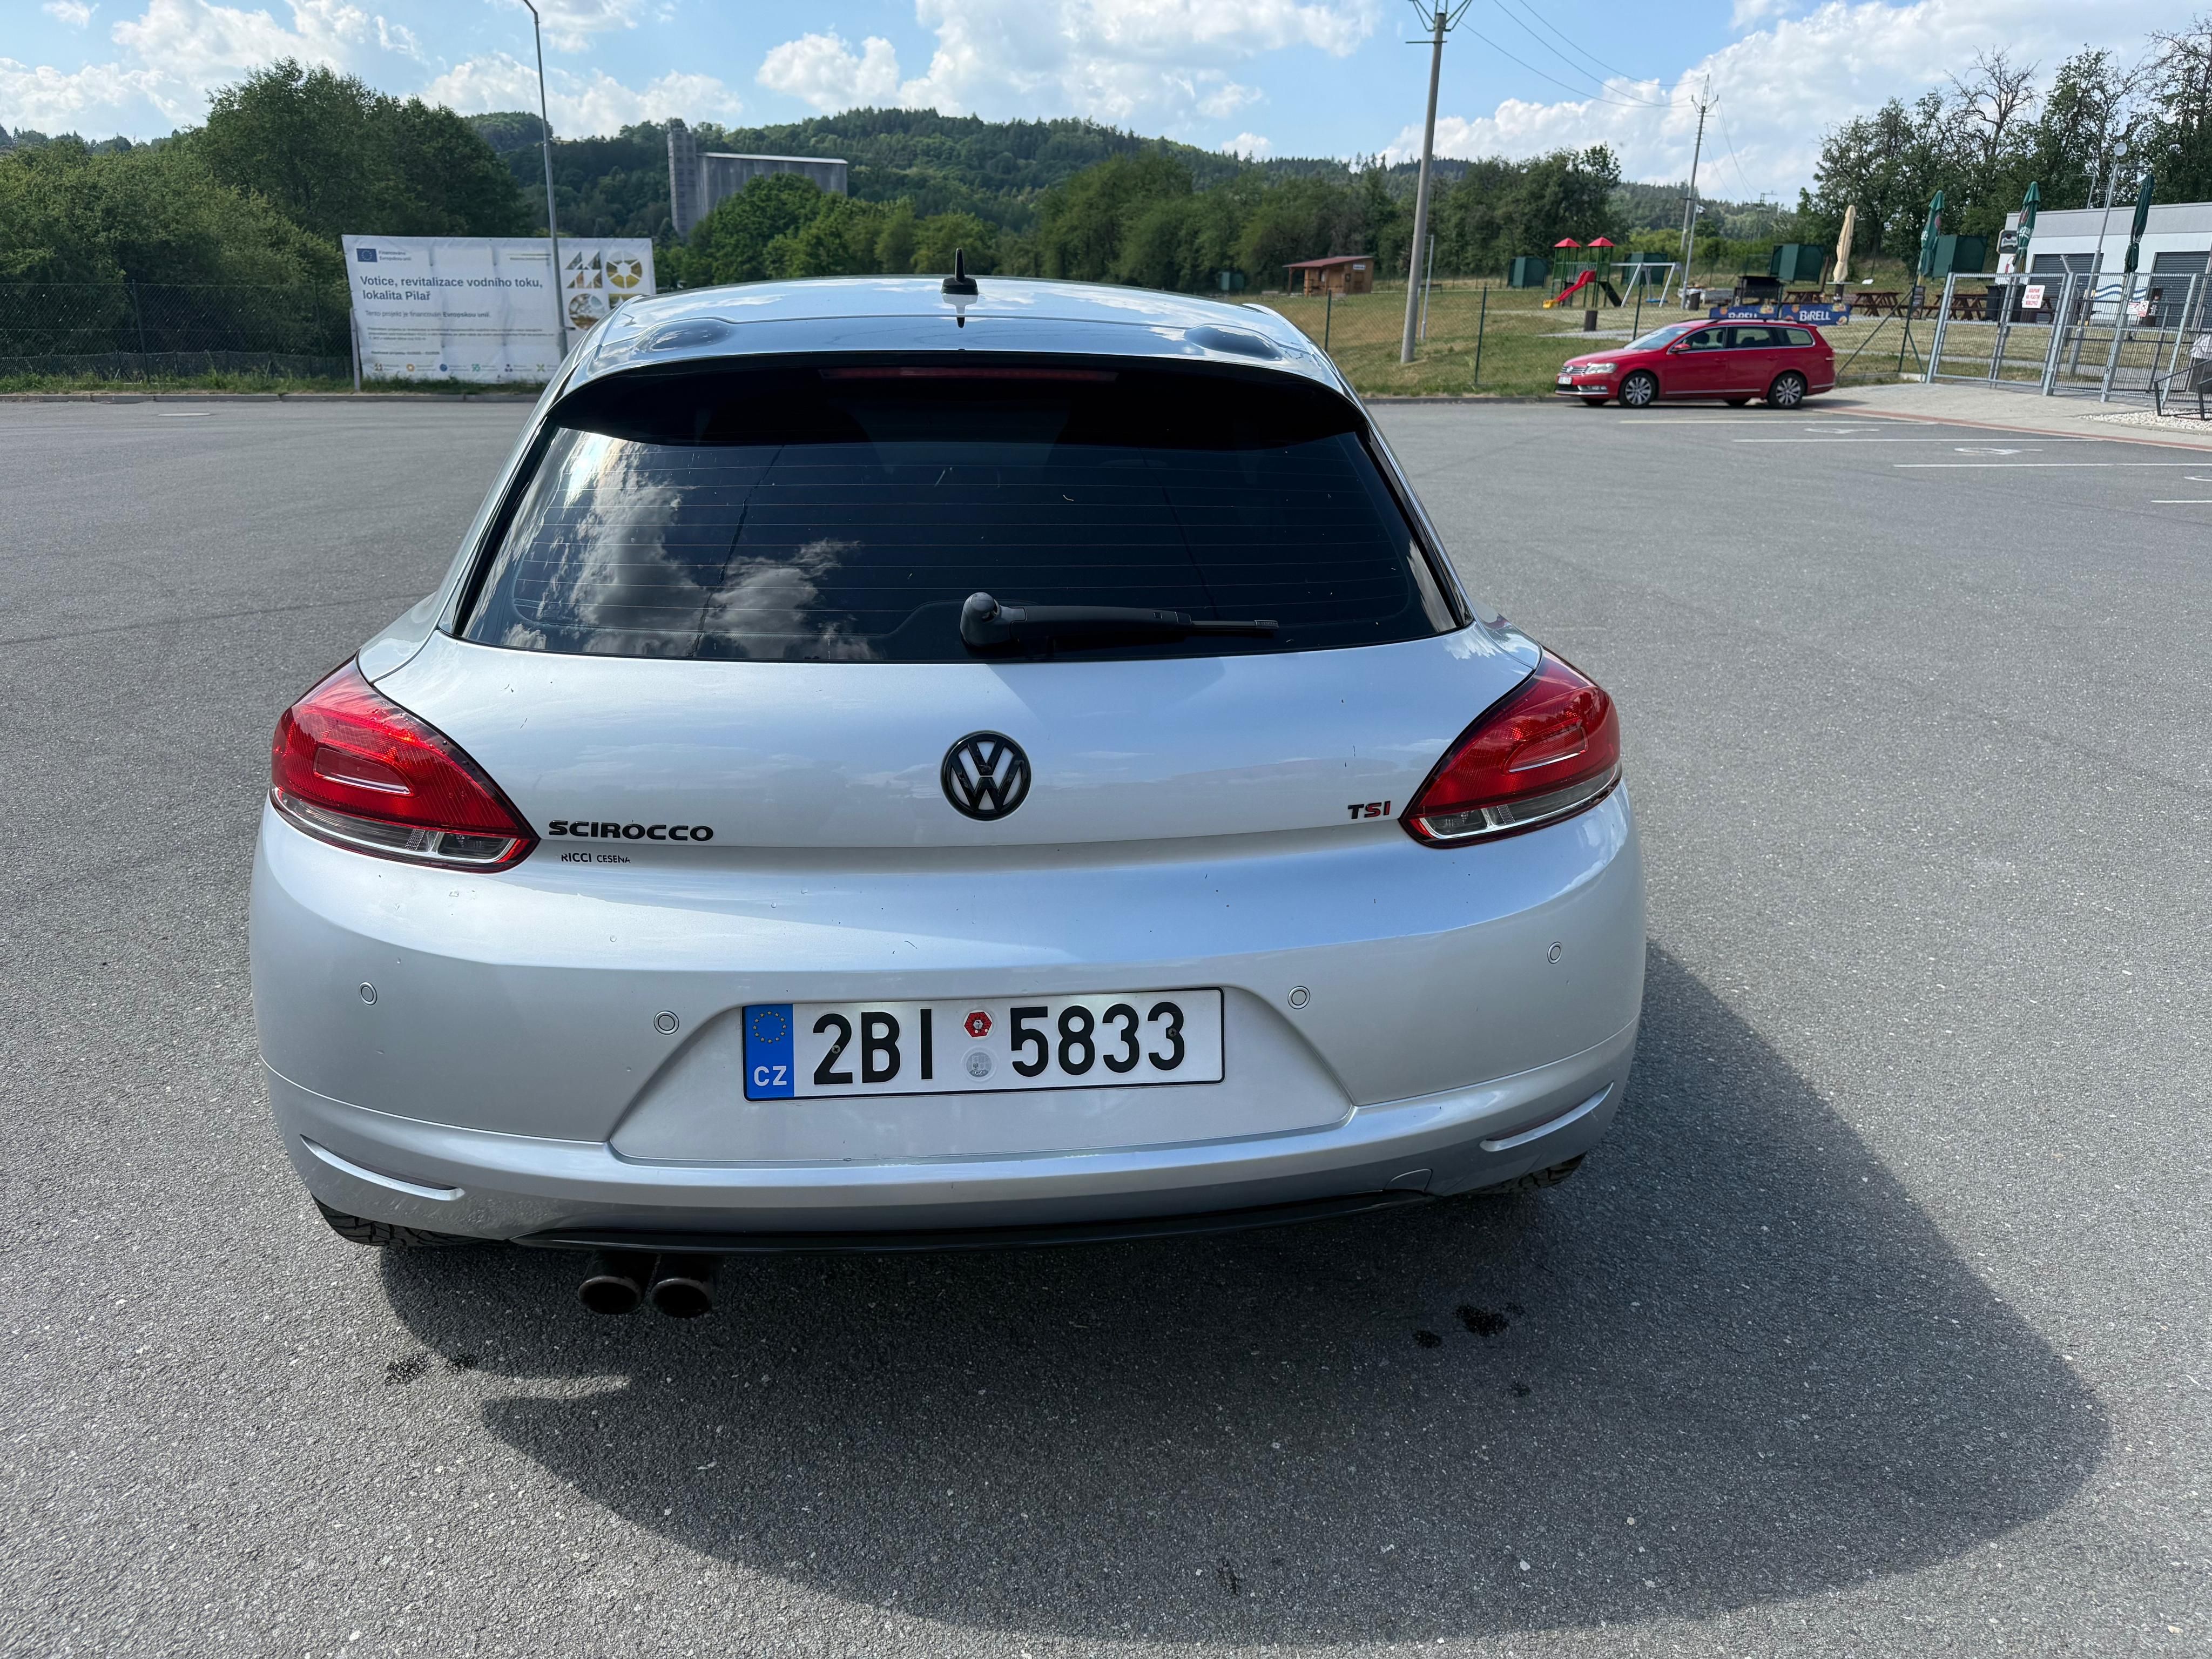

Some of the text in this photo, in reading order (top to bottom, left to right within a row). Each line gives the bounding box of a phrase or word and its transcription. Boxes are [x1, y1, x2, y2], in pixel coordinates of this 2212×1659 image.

[360, 275, 543, 288] Votice, revitalizace vodního toku,
[362, 290, 431, 300] lokalita Pilař
[1347, 800, 1391, 819] TSI
[549, 820, 714, 841] SCIROCCO
[561, 853, 631, 864] RICCI CESENA
[813, 1001, 1185, 1085] 2BI 5833
[754, 1065, 787, 1087] CZ
